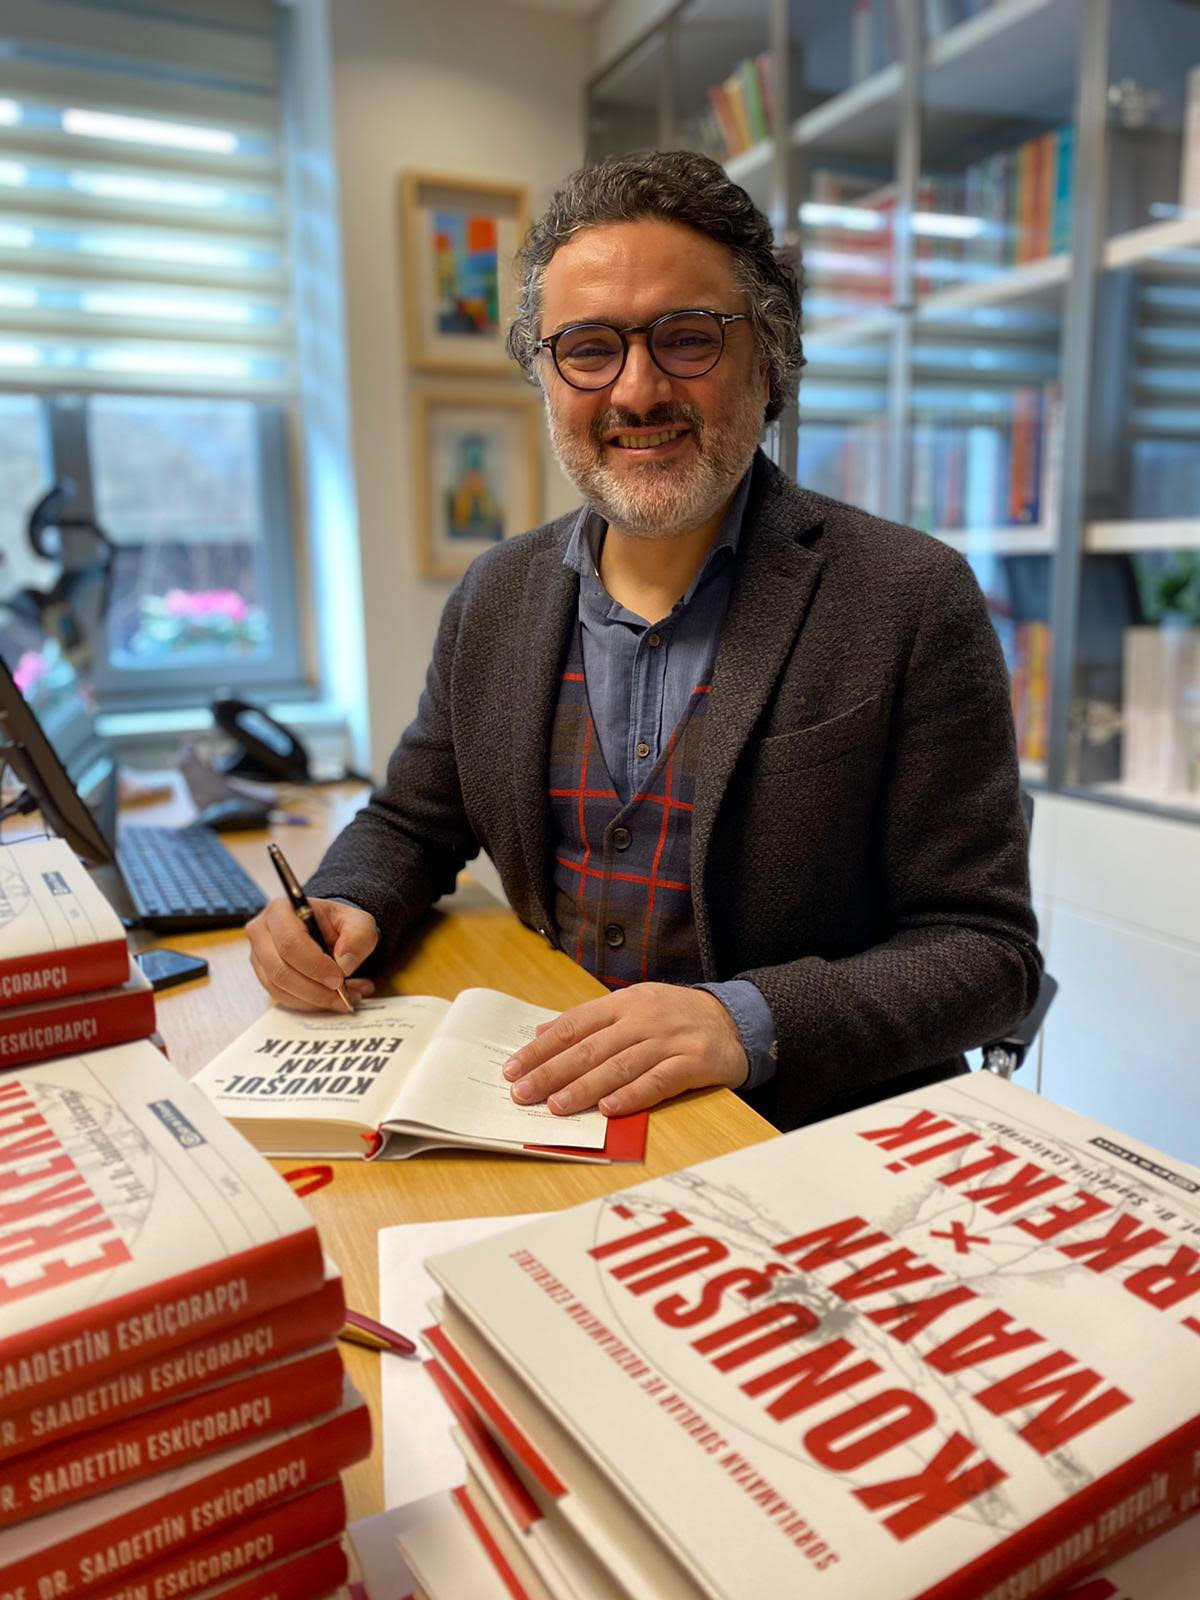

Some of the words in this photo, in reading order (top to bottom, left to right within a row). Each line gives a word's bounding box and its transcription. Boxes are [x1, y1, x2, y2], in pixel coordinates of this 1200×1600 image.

[0, 966, 68, 1000] ÇORAPÇI
[255, 1037, 404, 1058] ERKEKLİK
[275, 1056, 389, 1075] MAYAN
[857, 1109, 1200, 1336] RKEKLİK
[116, 1278, 248, 1351] ESKİÇORAPÇI
[771, 1215, 1134, 1456] MAYAN
[30, 1373, 144, 1436] SAADETTİN
[151, 1325, 274, 1392] ESKİÇORAPÇI
[587, 1203, 1012, 1543] KONUŞUL-
[640, 1371, 668, 1398] VE
[659, 1394, 729, 1455] SORULAR
[28, 1441, 141, 1501] SAADETTİN
[147, 1395, 271, 1460] ESKİÇORAPÇI
[79, 1514, 187, 1584] SAADETTİN
[191, 1458, 307, 1531] ESKİÇORAPÇI
[719, 1452, 840, 1571] SORULAMAYAN
